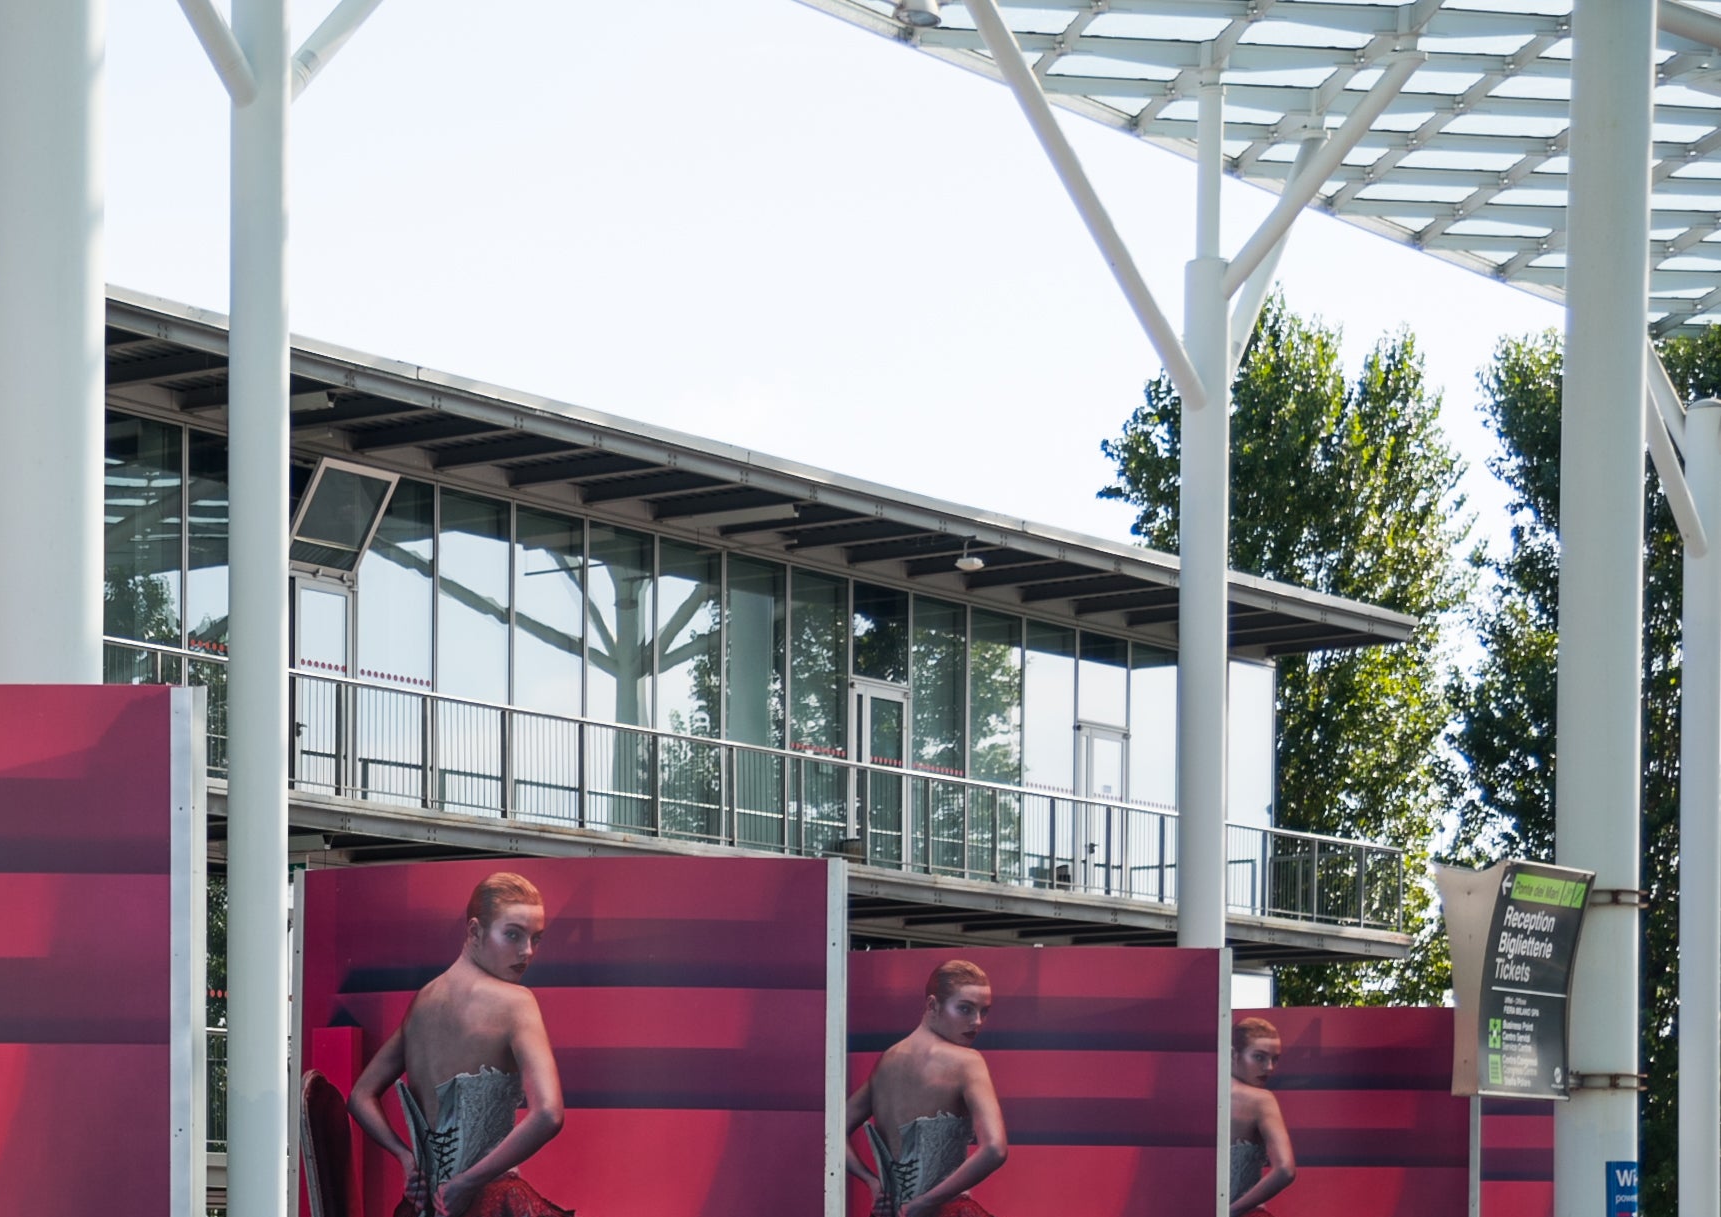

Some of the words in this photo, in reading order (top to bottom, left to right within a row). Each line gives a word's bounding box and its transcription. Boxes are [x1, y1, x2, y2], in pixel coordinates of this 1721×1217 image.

[1503, 905, 1556, 934] Reception
[1498, 932, 1553, 960] Biglietterie
[1494, 957, 1531, 983] Tickets
[1615, 1169, 1637, 1187] Wi
